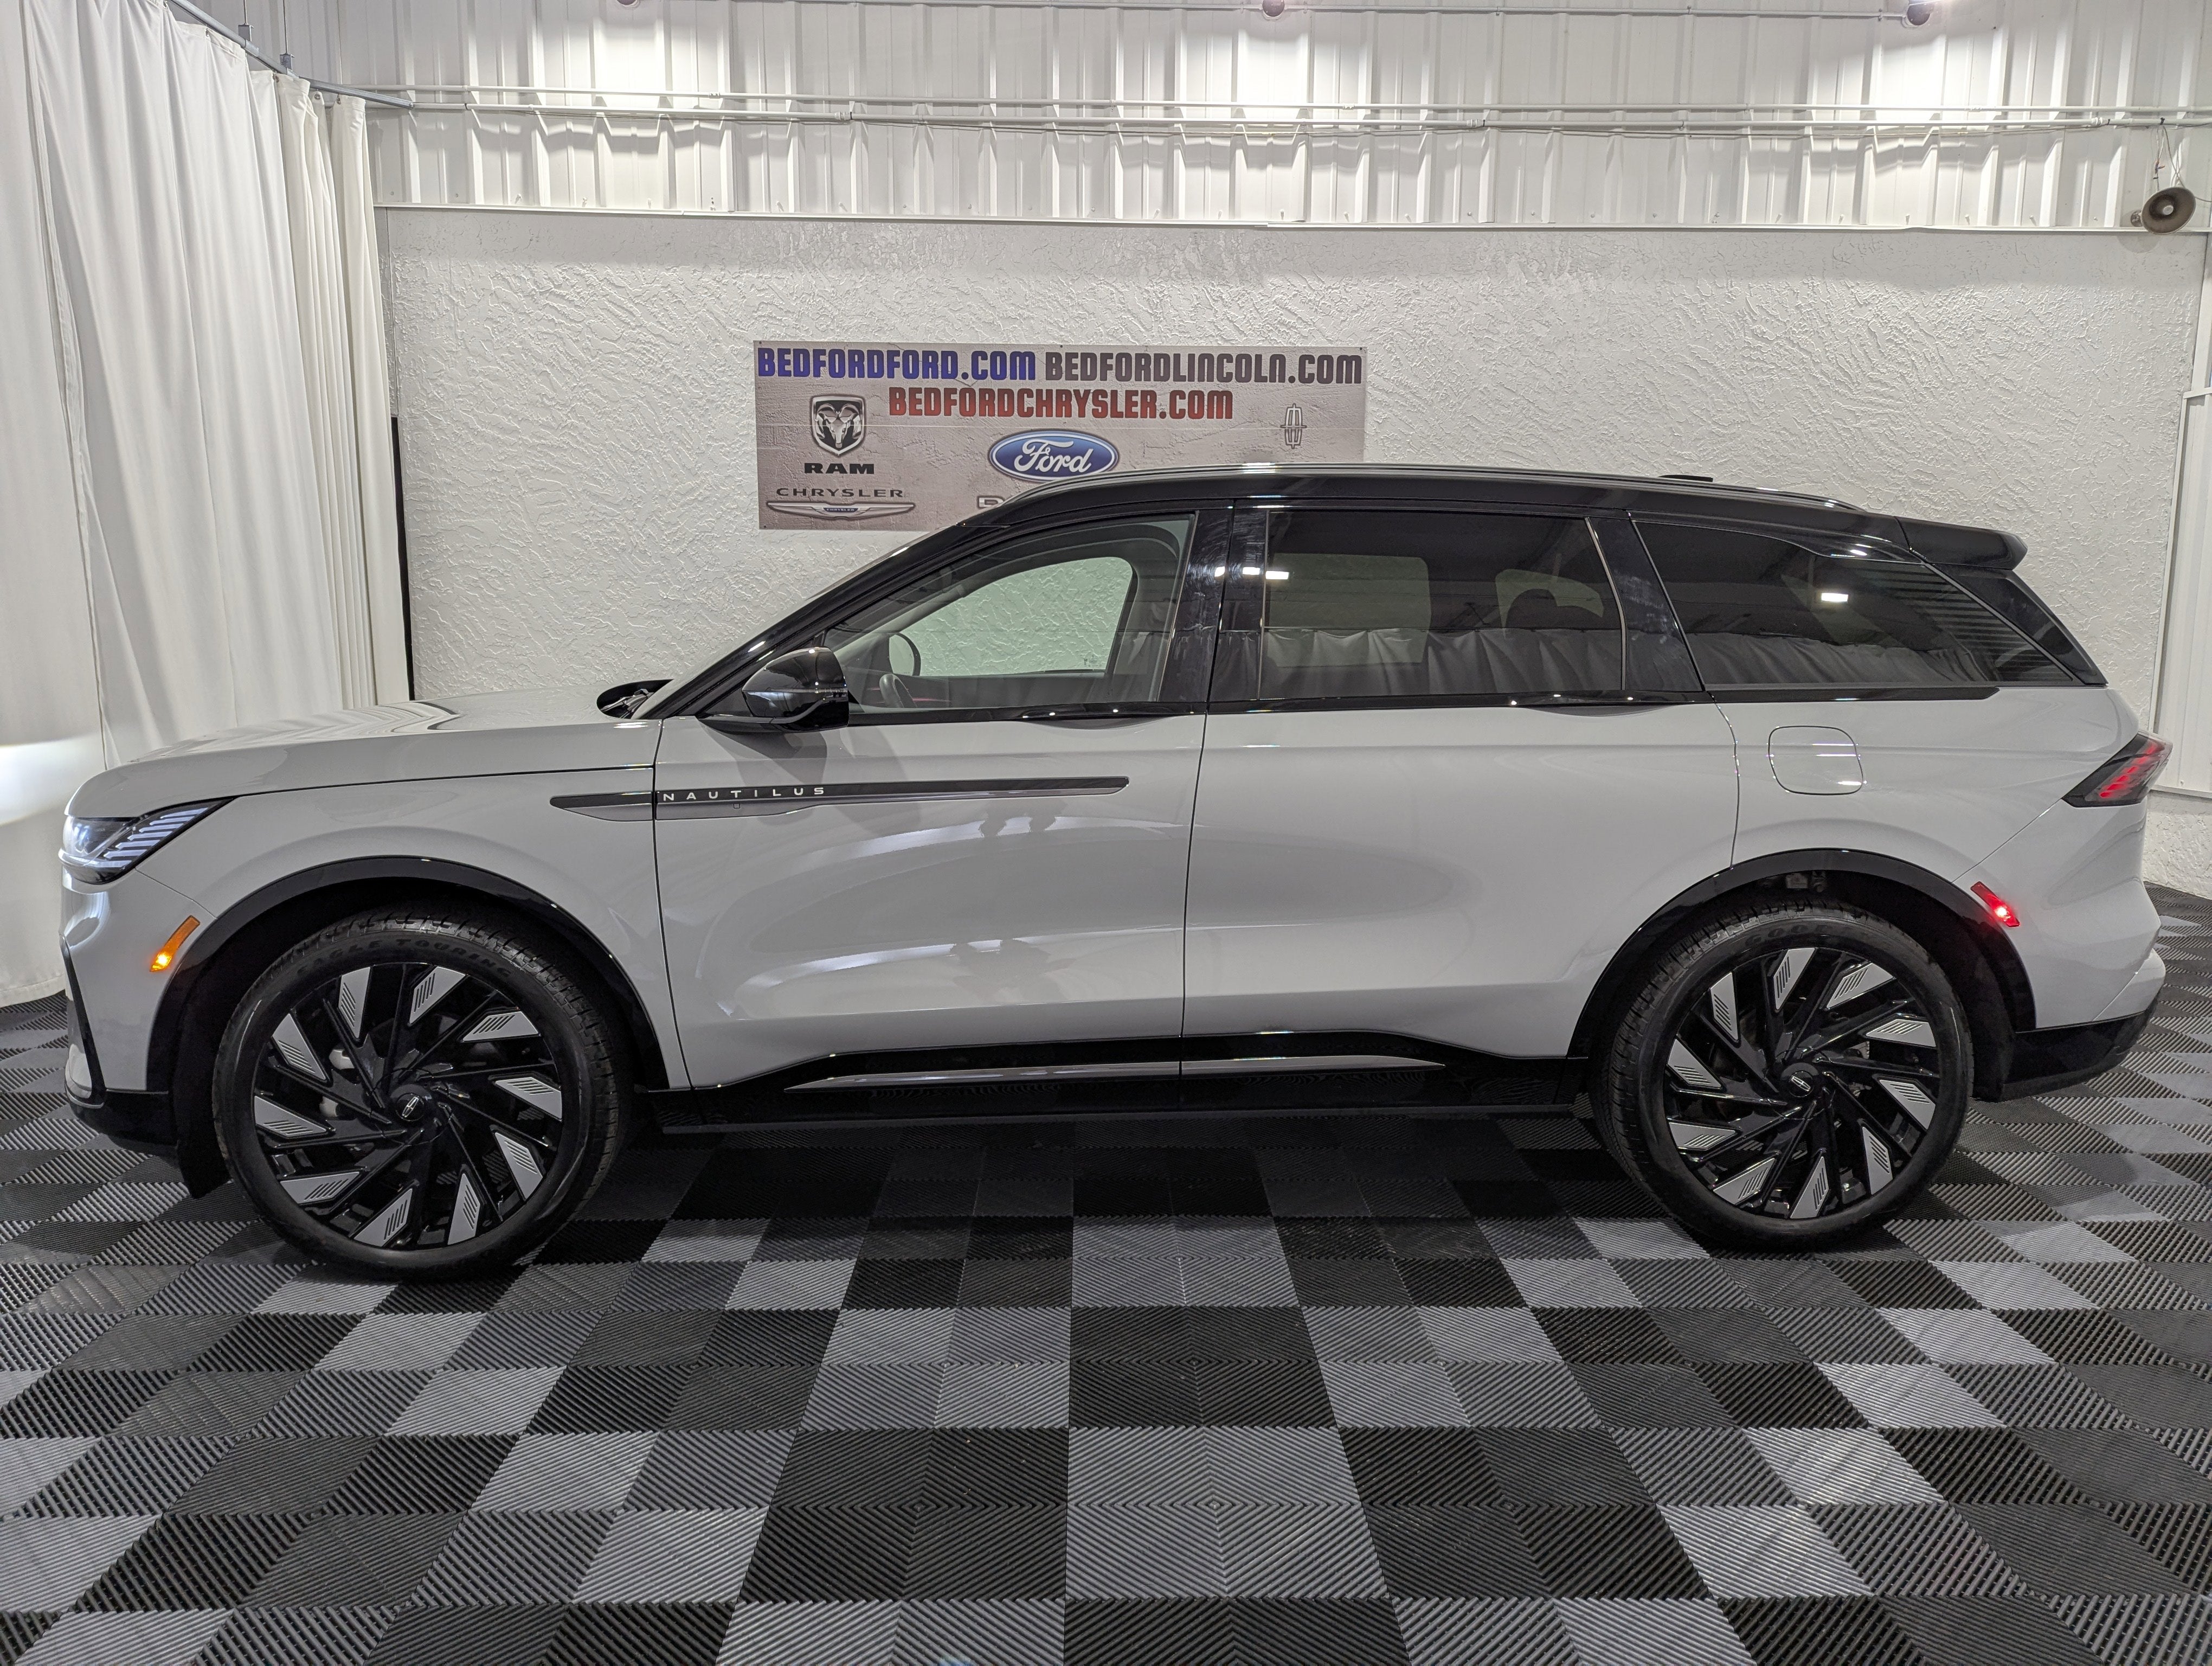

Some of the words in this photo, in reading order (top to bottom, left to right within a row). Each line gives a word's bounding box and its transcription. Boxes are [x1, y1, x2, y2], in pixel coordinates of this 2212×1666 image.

[758, 348, 1036, 381] BEDFORDFORD.COM
[1045, 352, 1362, 385] BEDFORDLINCOLN.COM
[889, 387, 1233, 420] BEDFORDCHRYSLER.COM
[1014, 439, 1094, 473] Ford
[804, 463, 874, 475] RAM
[776, 488, 904, 498] CHRYSLER
[663, 787, 824, 801] NAUTILUS
